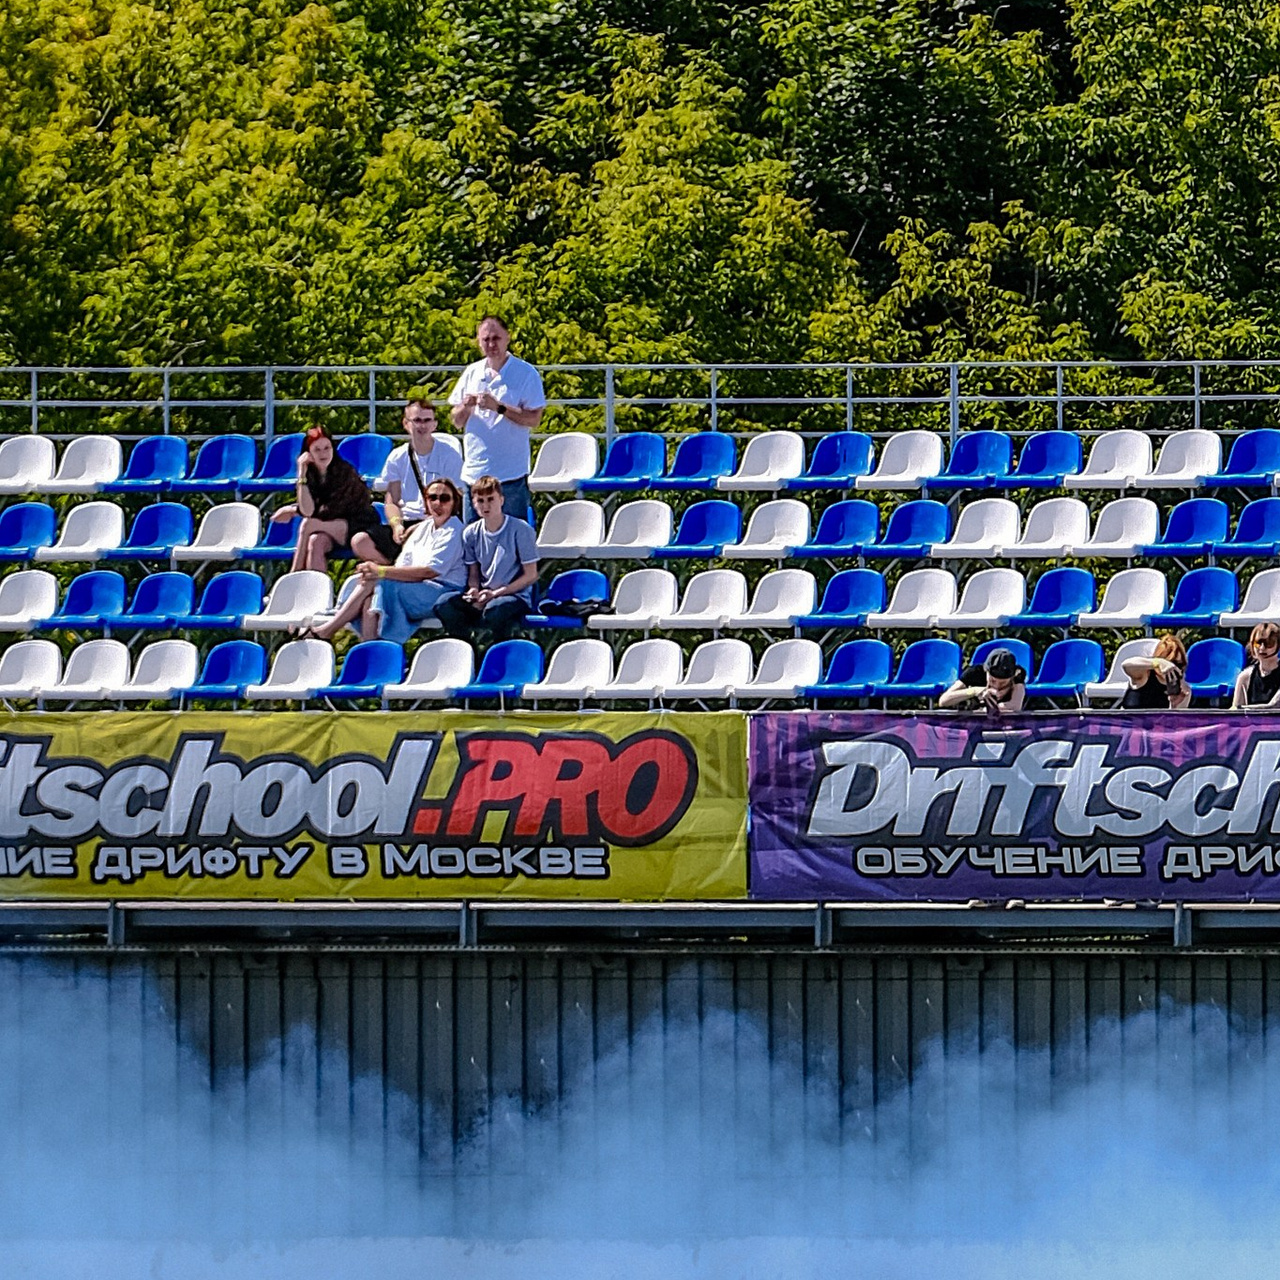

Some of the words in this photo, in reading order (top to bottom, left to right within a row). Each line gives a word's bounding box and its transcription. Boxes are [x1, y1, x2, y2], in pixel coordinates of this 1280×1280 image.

[0, 736, 690, 838] tschool.PRO
[0, 846, 75, 876] ИЕ
[94, 845, 310, 881] ДРИФТУ
[331, 846, 367, 876] В
[384, 843, 607, 876] МОСКВЕ
[856, 846, 1142, 875] ОБУЧЕНИЕ
